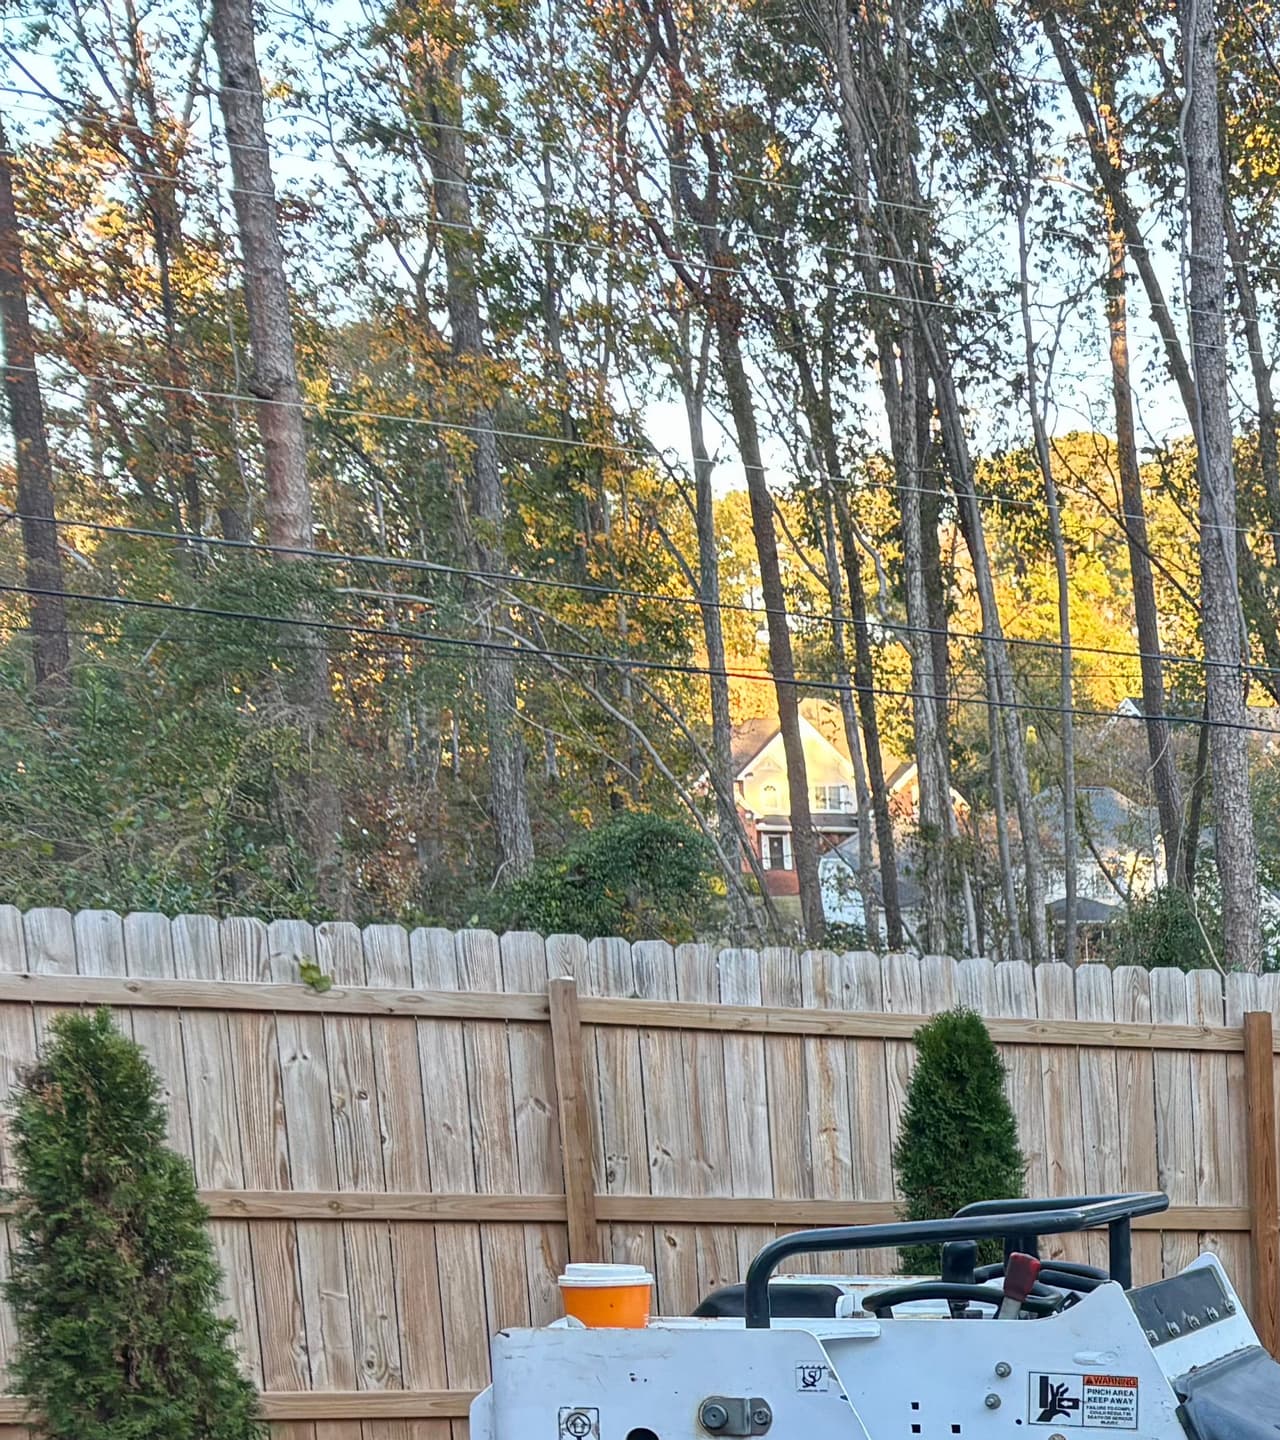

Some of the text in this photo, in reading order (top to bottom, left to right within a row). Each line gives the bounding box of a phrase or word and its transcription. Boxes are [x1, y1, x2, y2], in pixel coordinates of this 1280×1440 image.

[1094, 1376, 1136, 1386] WARNING
[1087, 1388, 1134, 1397] PINCH AREA
[1088, 1396, 1133, 1405] KEEP AWAY
